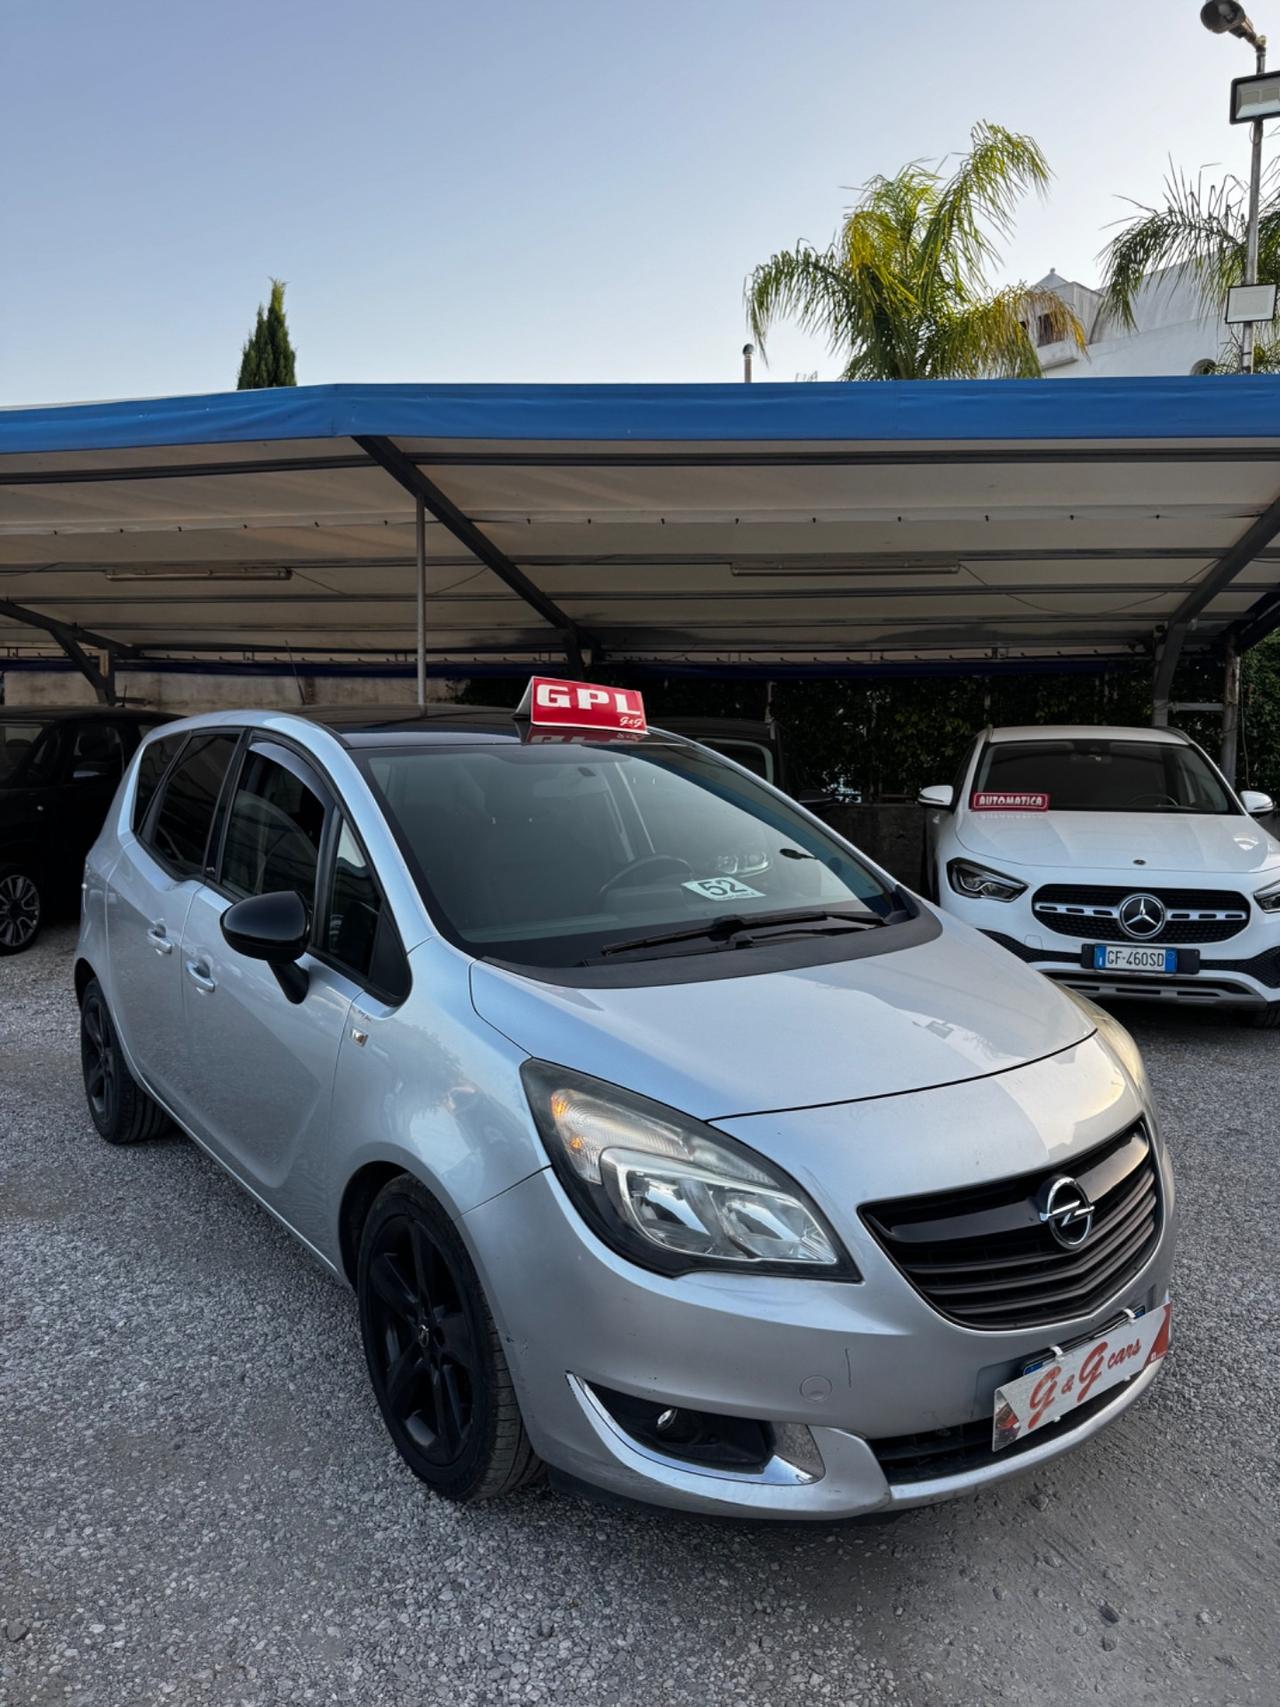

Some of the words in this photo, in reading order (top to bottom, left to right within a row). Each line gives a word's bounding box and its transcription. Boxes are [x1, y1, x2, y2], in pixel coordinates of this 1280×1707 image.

[537, 684, 640, 714] GPL
[979, 795, 1043, 806] AUTOMATICA
[697, 880, 748, 896] 52
[1107, 1338, 1142, 1370] cars
